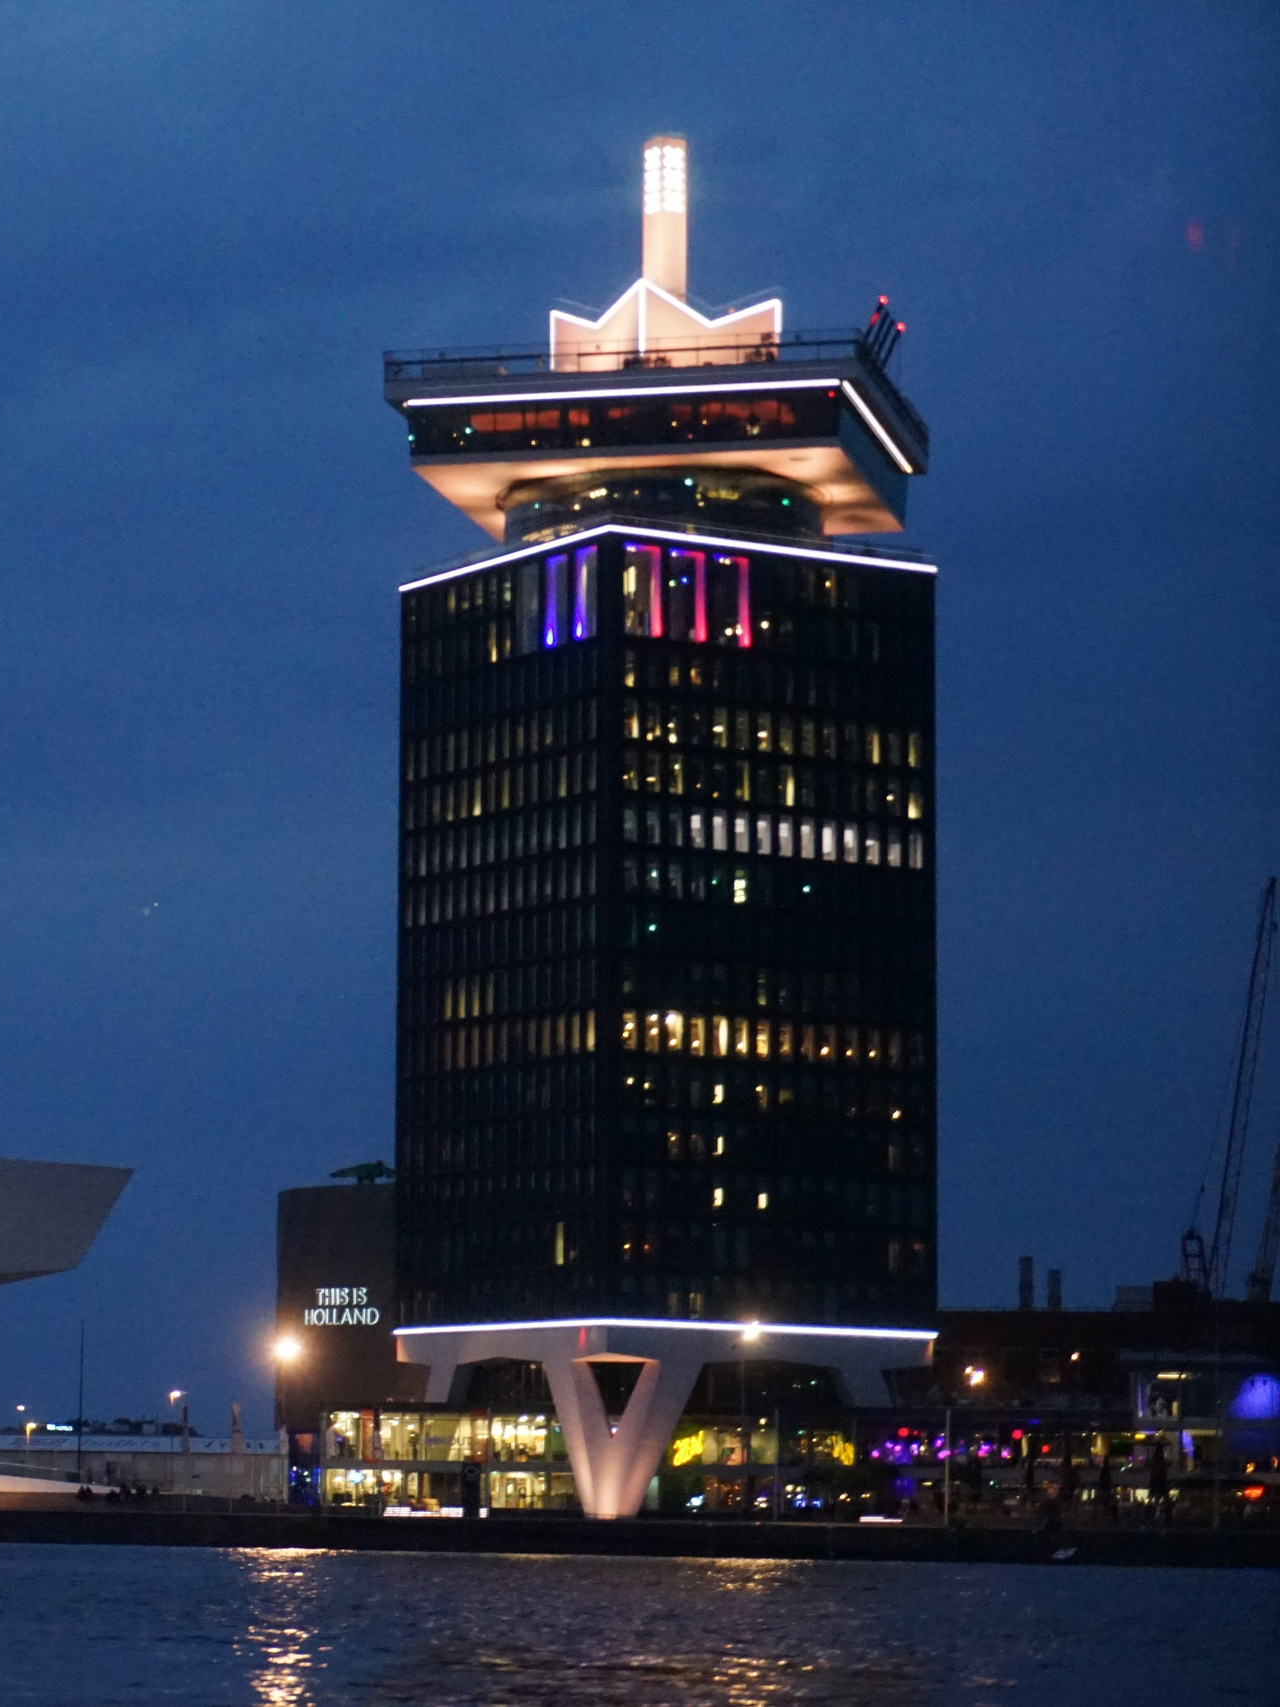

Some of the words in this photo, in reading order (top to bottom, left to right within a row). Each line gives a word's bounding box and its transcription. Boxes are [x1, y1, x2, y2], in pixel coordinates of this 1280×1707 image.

[316, 1287, 349, 1306] THIS
[352, 1287, 367, 1306] IS
[304, 1307, 380, 1326] HOLLAND
